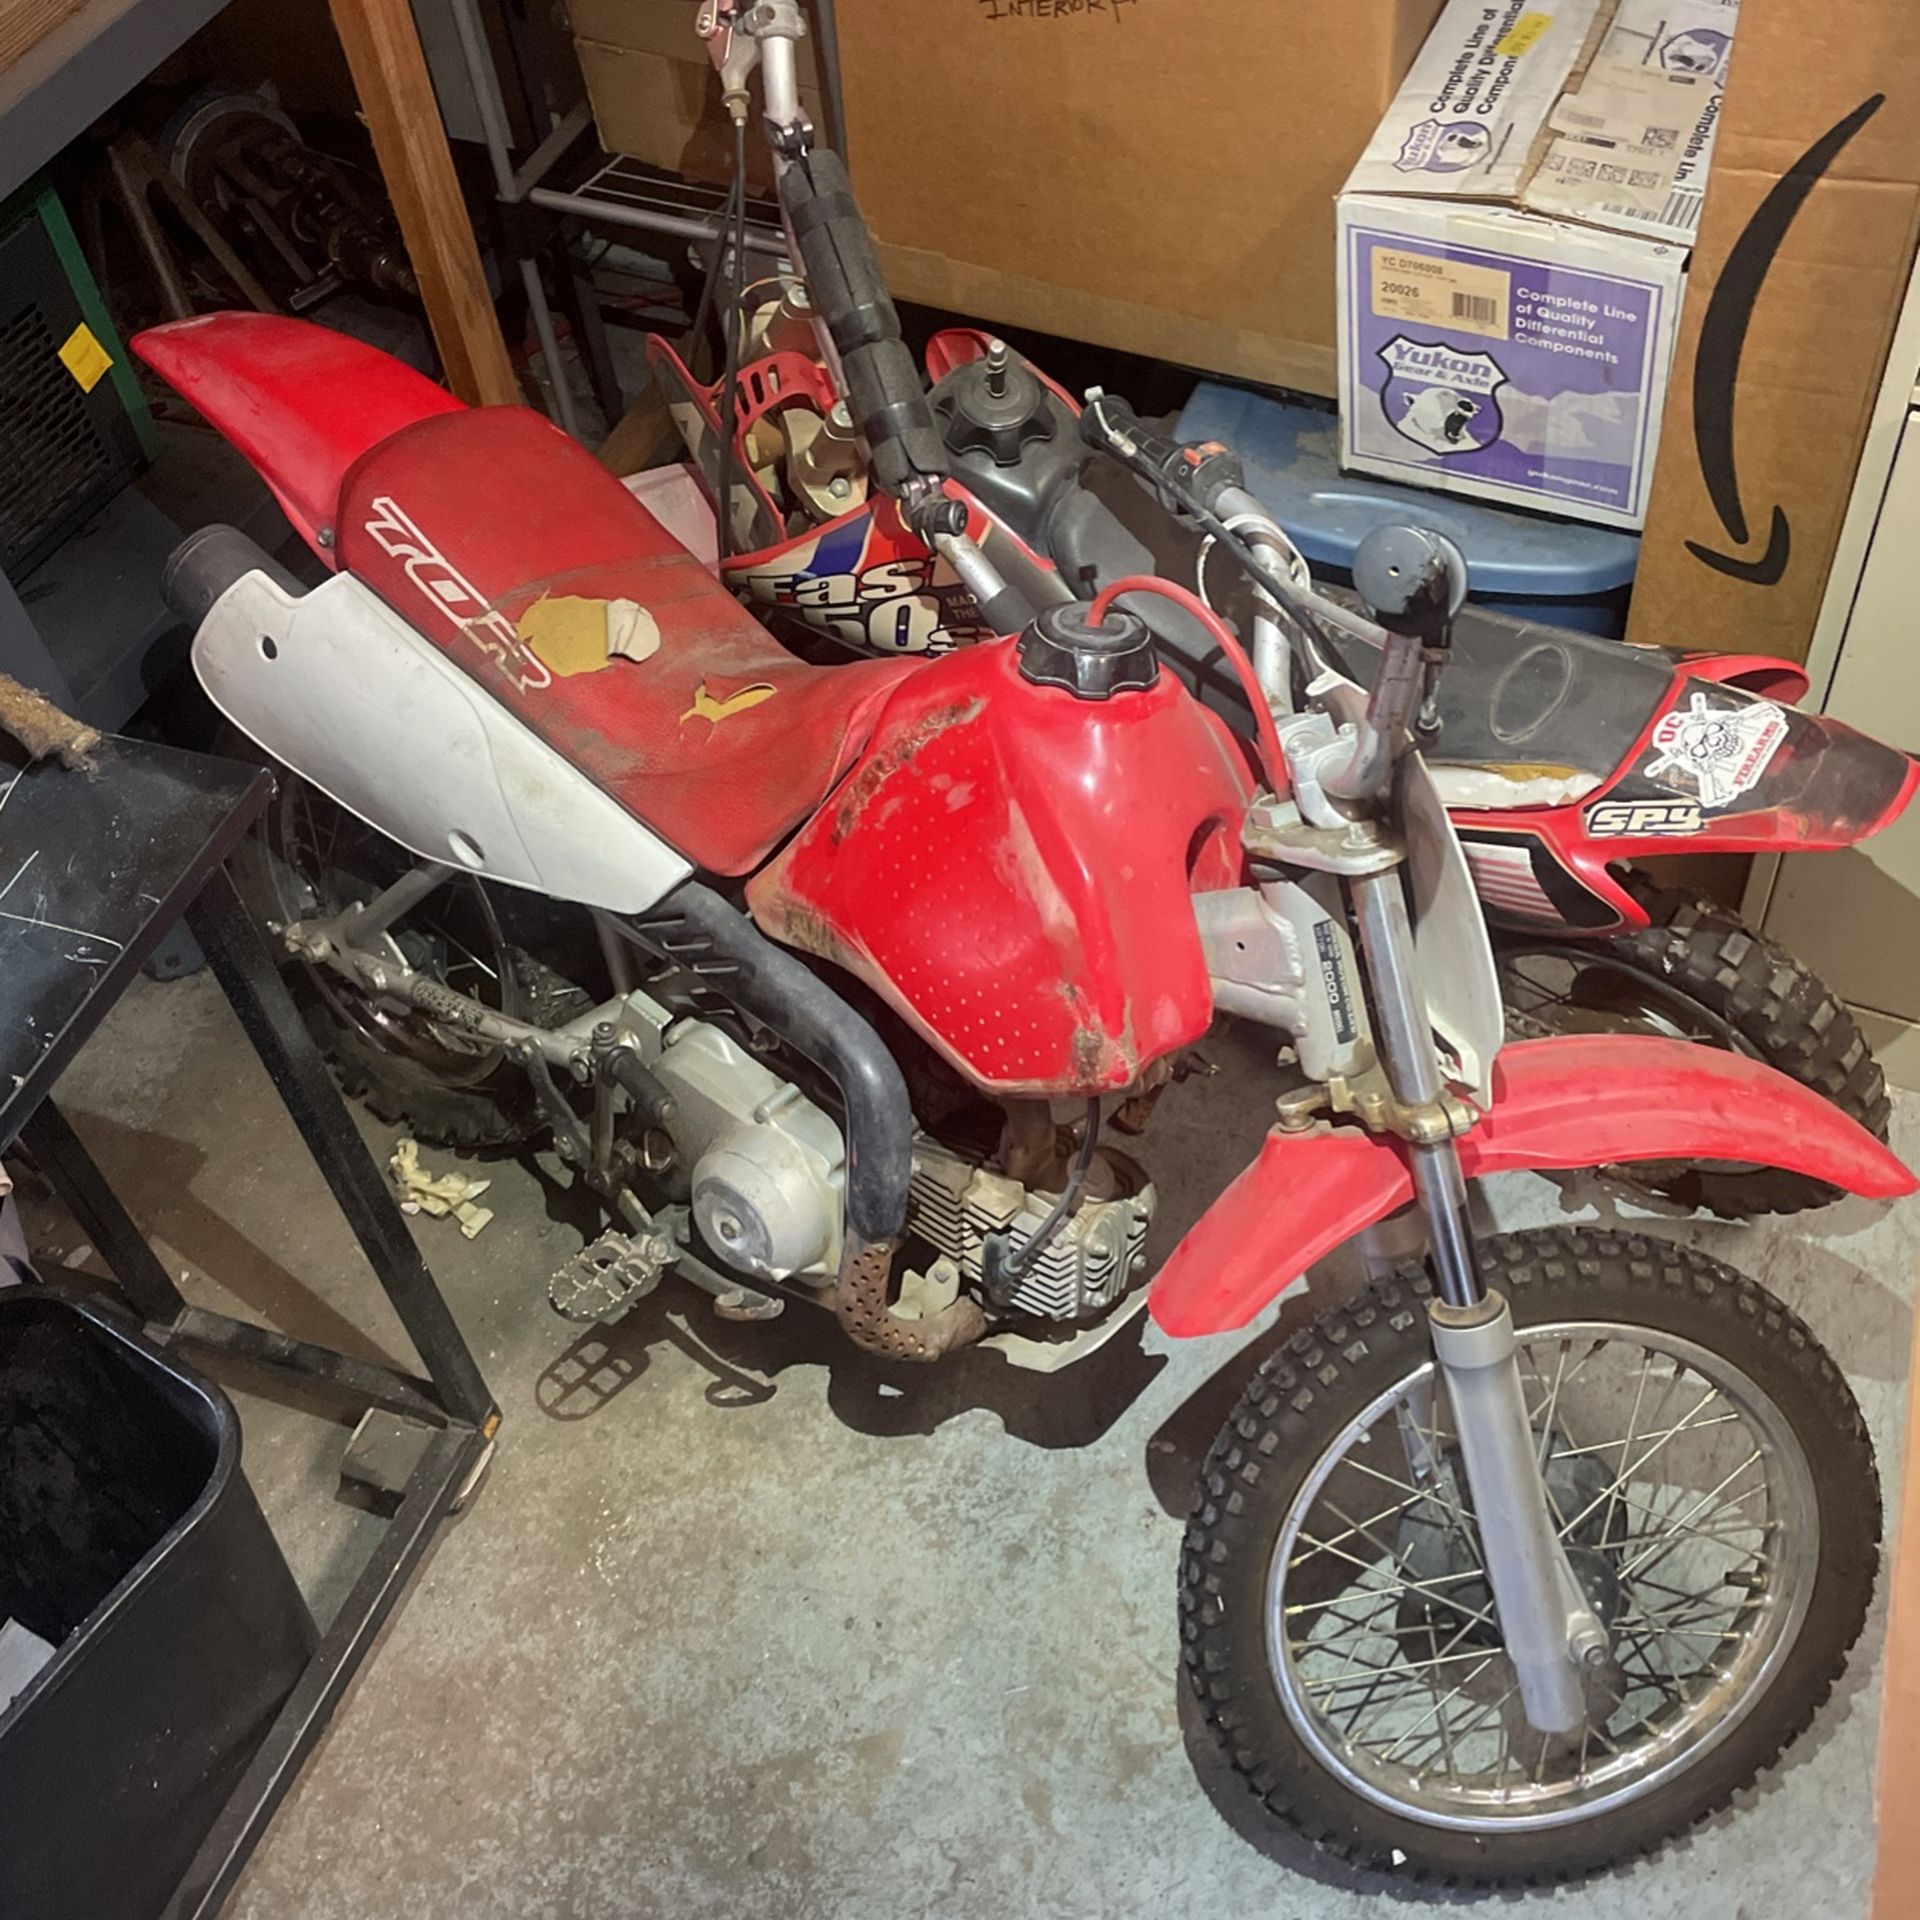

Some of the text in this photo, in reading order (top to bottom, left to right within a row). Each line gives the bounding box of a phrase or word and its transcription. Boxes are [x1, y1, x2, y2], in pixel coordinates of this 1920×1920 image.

[1429, 8, 1499, 113] Complete Line of
[1453, 66, 1493, 114] Quality
[1683, 94, 1723, 159] Complete
[1381, 256, 1397, 267] YC
[1381, 281, 1420, 298] 20026
[1516, 287, 1637, 322] Complete Line
[1515, 317, 1604, 346] Differential
[1516, 303, 1596, 330] of Quality
[1393, 343, 1492, 378] Yukon
[1514, 332, 1618, 364] Components
[1392, 361, 1490, 388] Gear & Axle
[1658, 715, 1684, 744] OC
[1734, 720, 1781, 788] FIREARMS
[1592, 807, 1701, 832] SPY
[1321, 960, 1340, 1005] 2000
